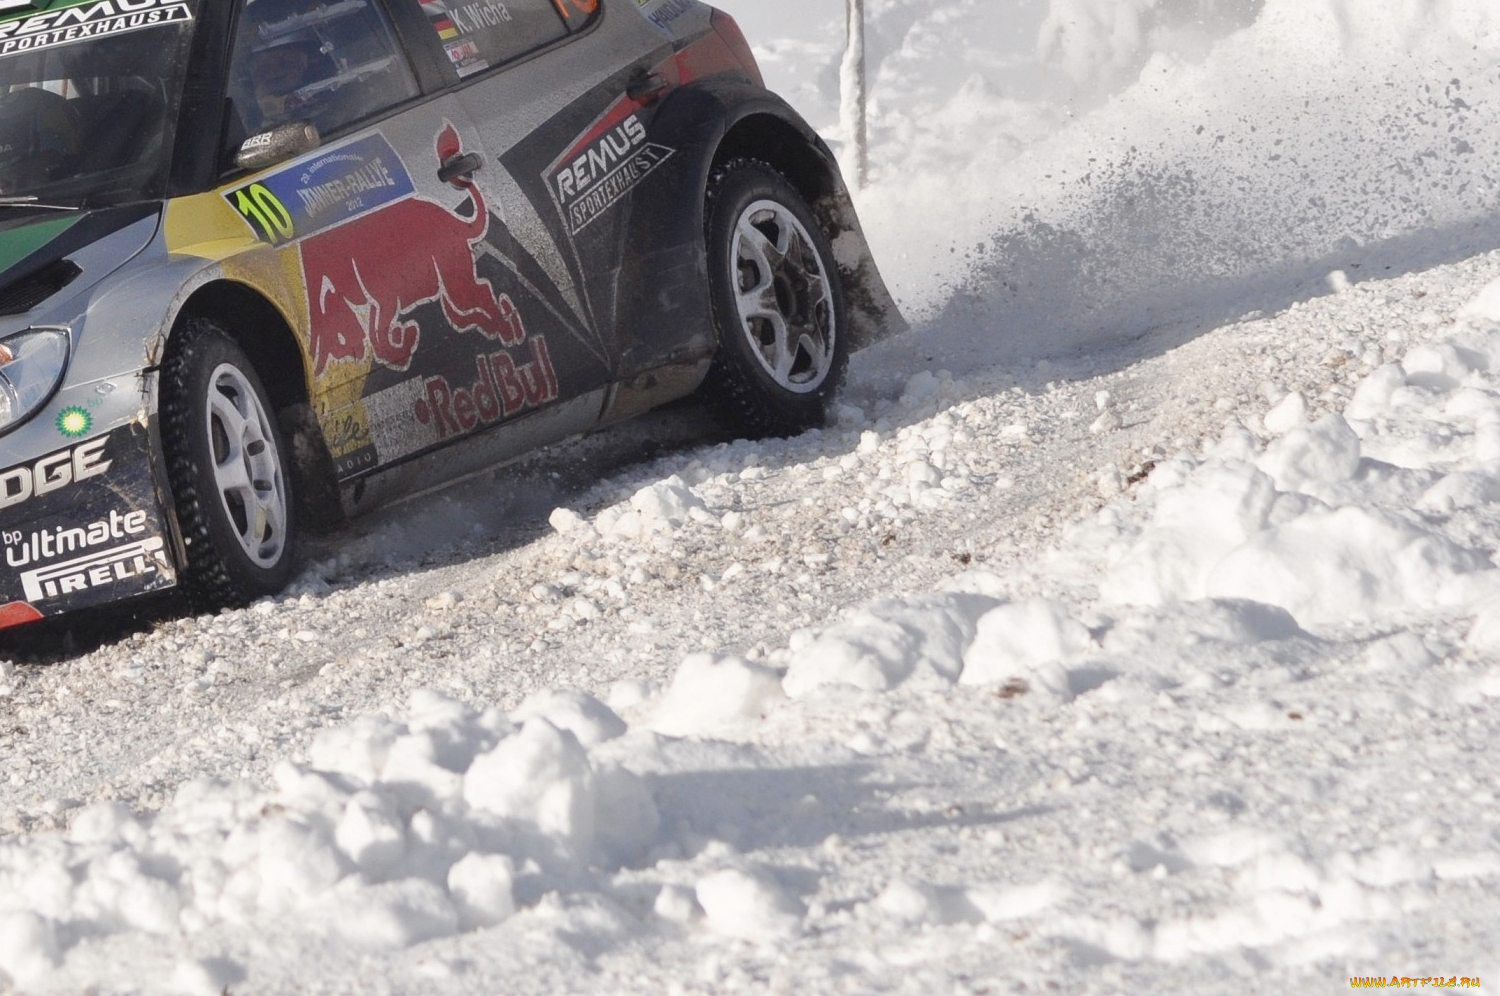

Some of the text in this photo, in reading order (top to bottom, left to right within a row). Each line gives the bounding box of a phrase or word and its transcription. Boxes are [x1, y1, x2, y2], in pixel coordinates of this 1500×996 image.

[463, 0, 512, 29] Wicha
[241, 132, 273, 151] BRR
[556, 114, 646, 204] REMUS
[235, 183, 294, 245] 10
[573, 147, 660, 225] SPORTEXHAUST
[424, 354, 500, 438] Red
[2, 530, 23, 546] bp
[6, 509, 147, 567] ultimate
[20, 536, 172, 602] PIRELLI
